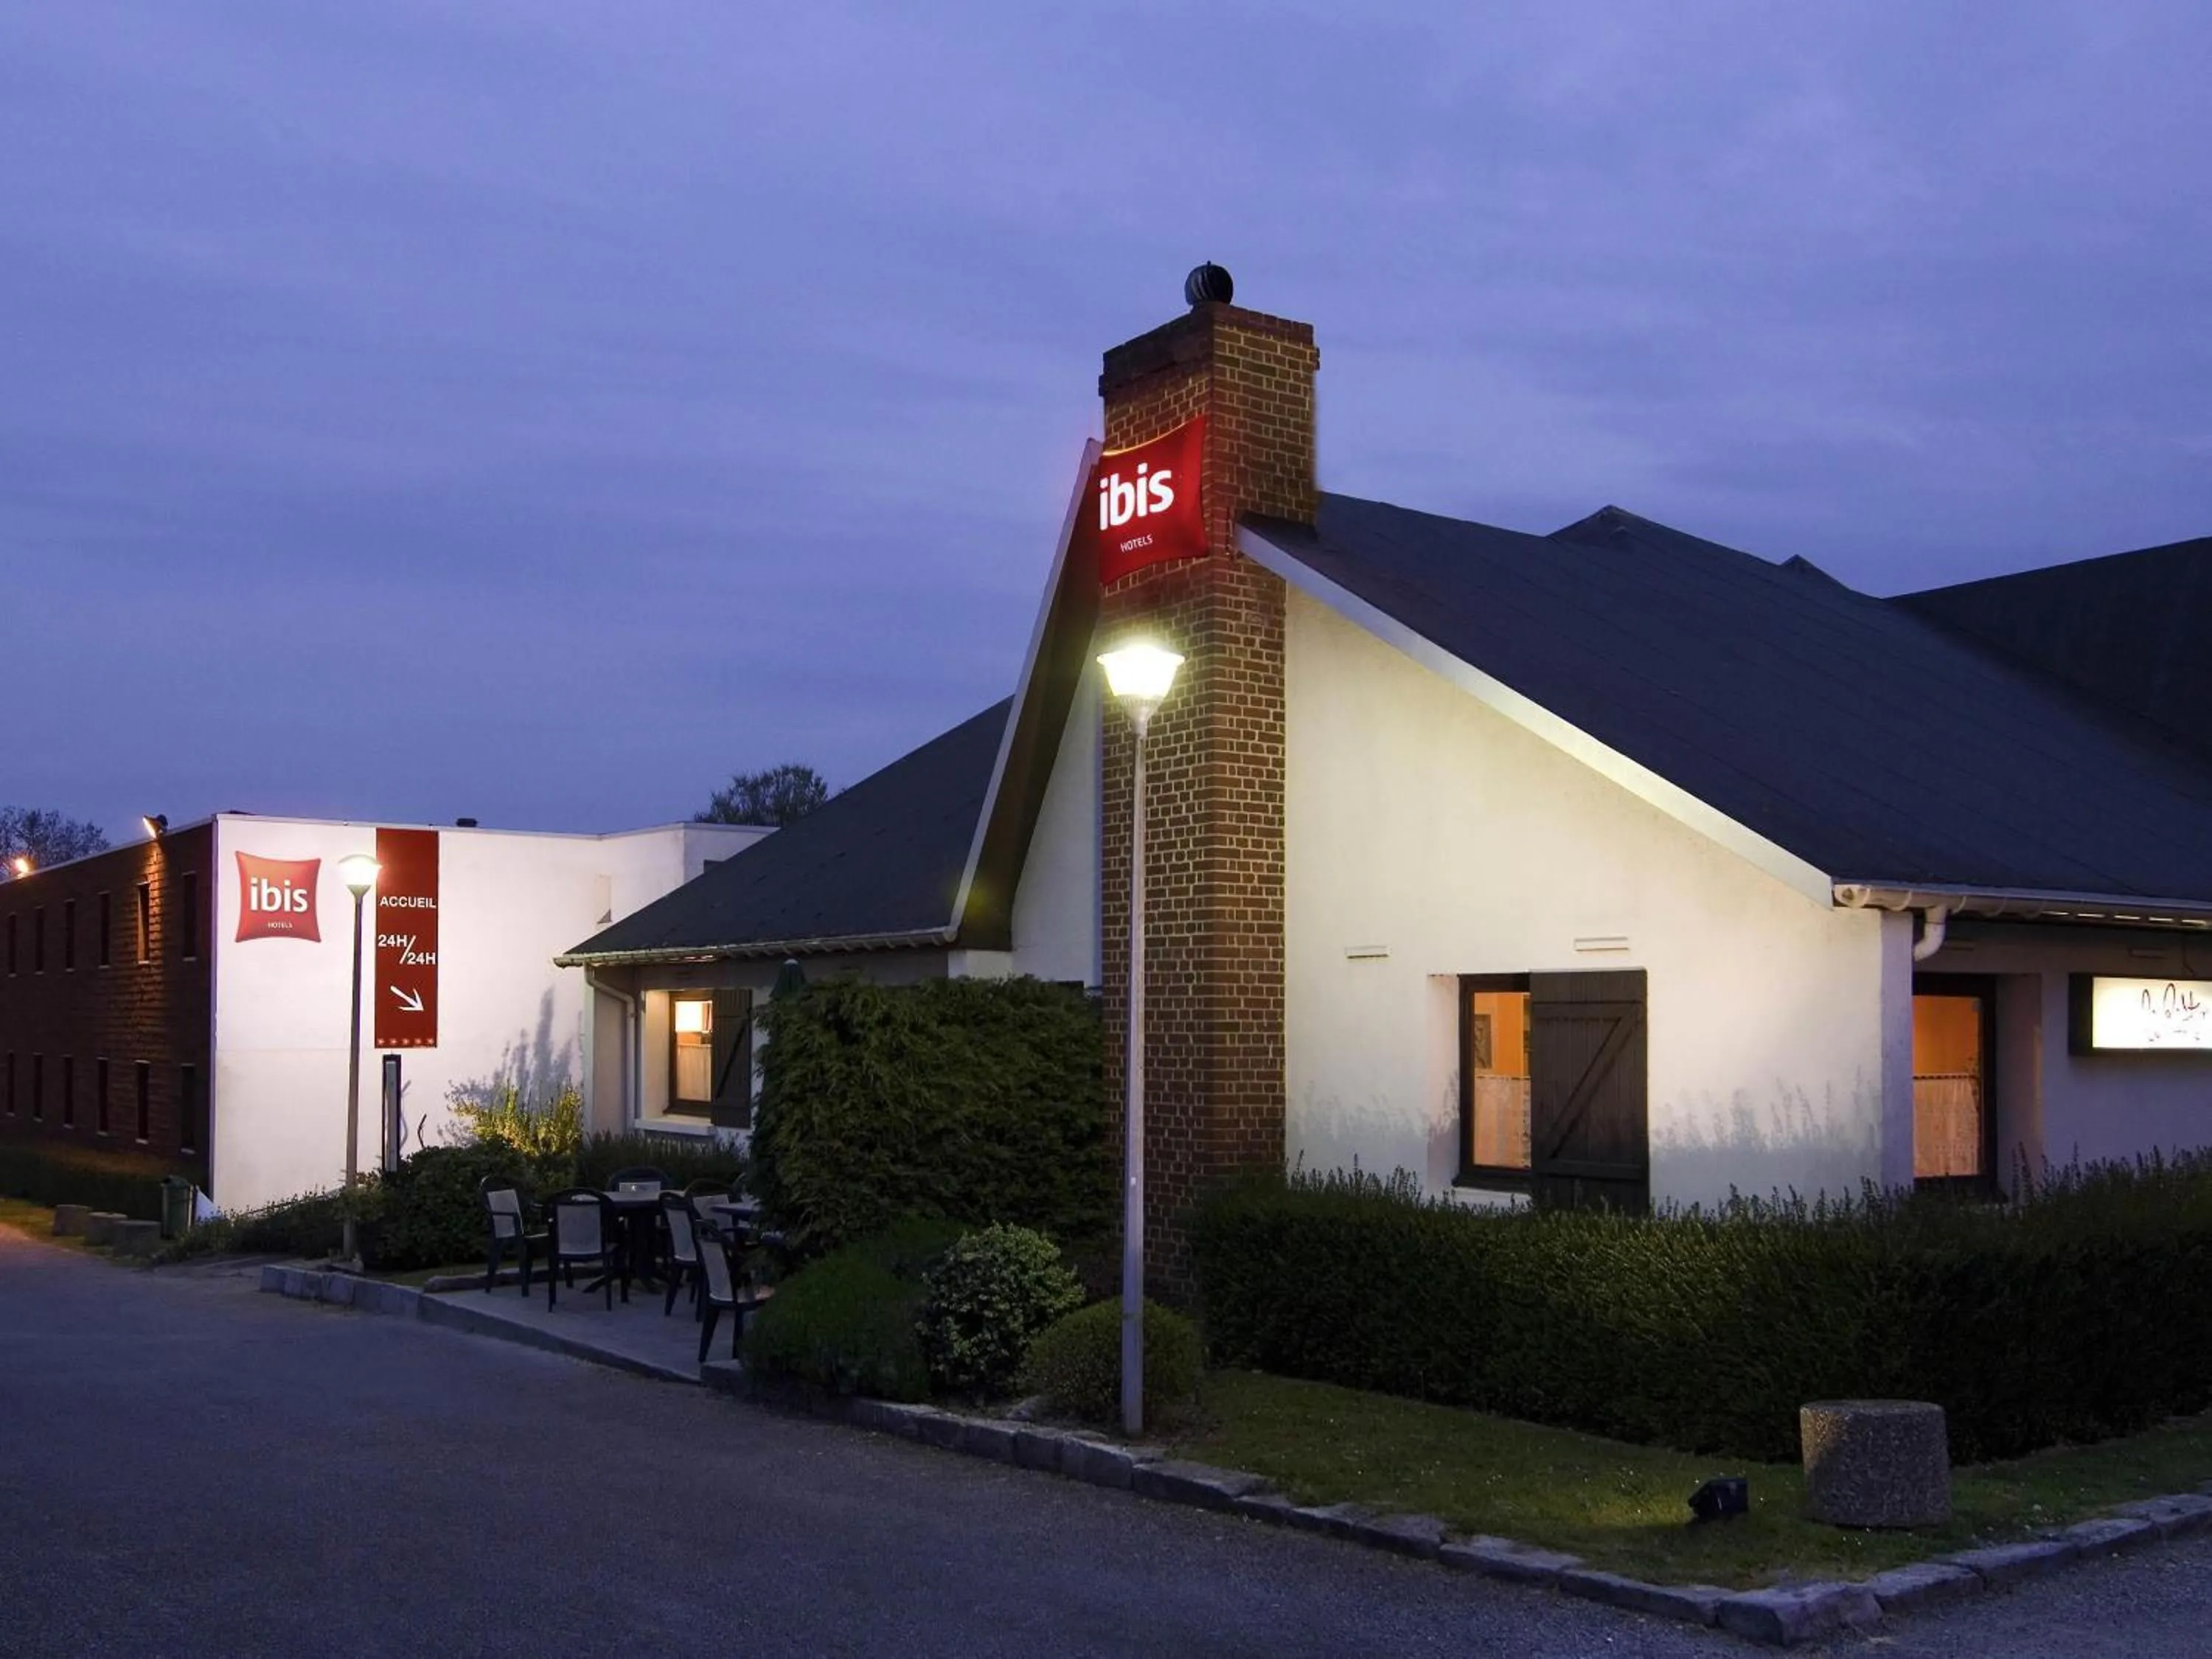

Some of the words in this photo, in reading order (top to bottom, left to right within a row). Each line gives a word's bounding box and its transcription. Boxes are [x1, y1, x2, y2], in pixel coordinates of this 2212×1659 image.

[1099, 462, 1174, 530] ibis
[1120, 535, 1153, 552] HOTELS
[249, 876, 308, 913] ibis
[379, 896, 437, 909] ACCUEIL
